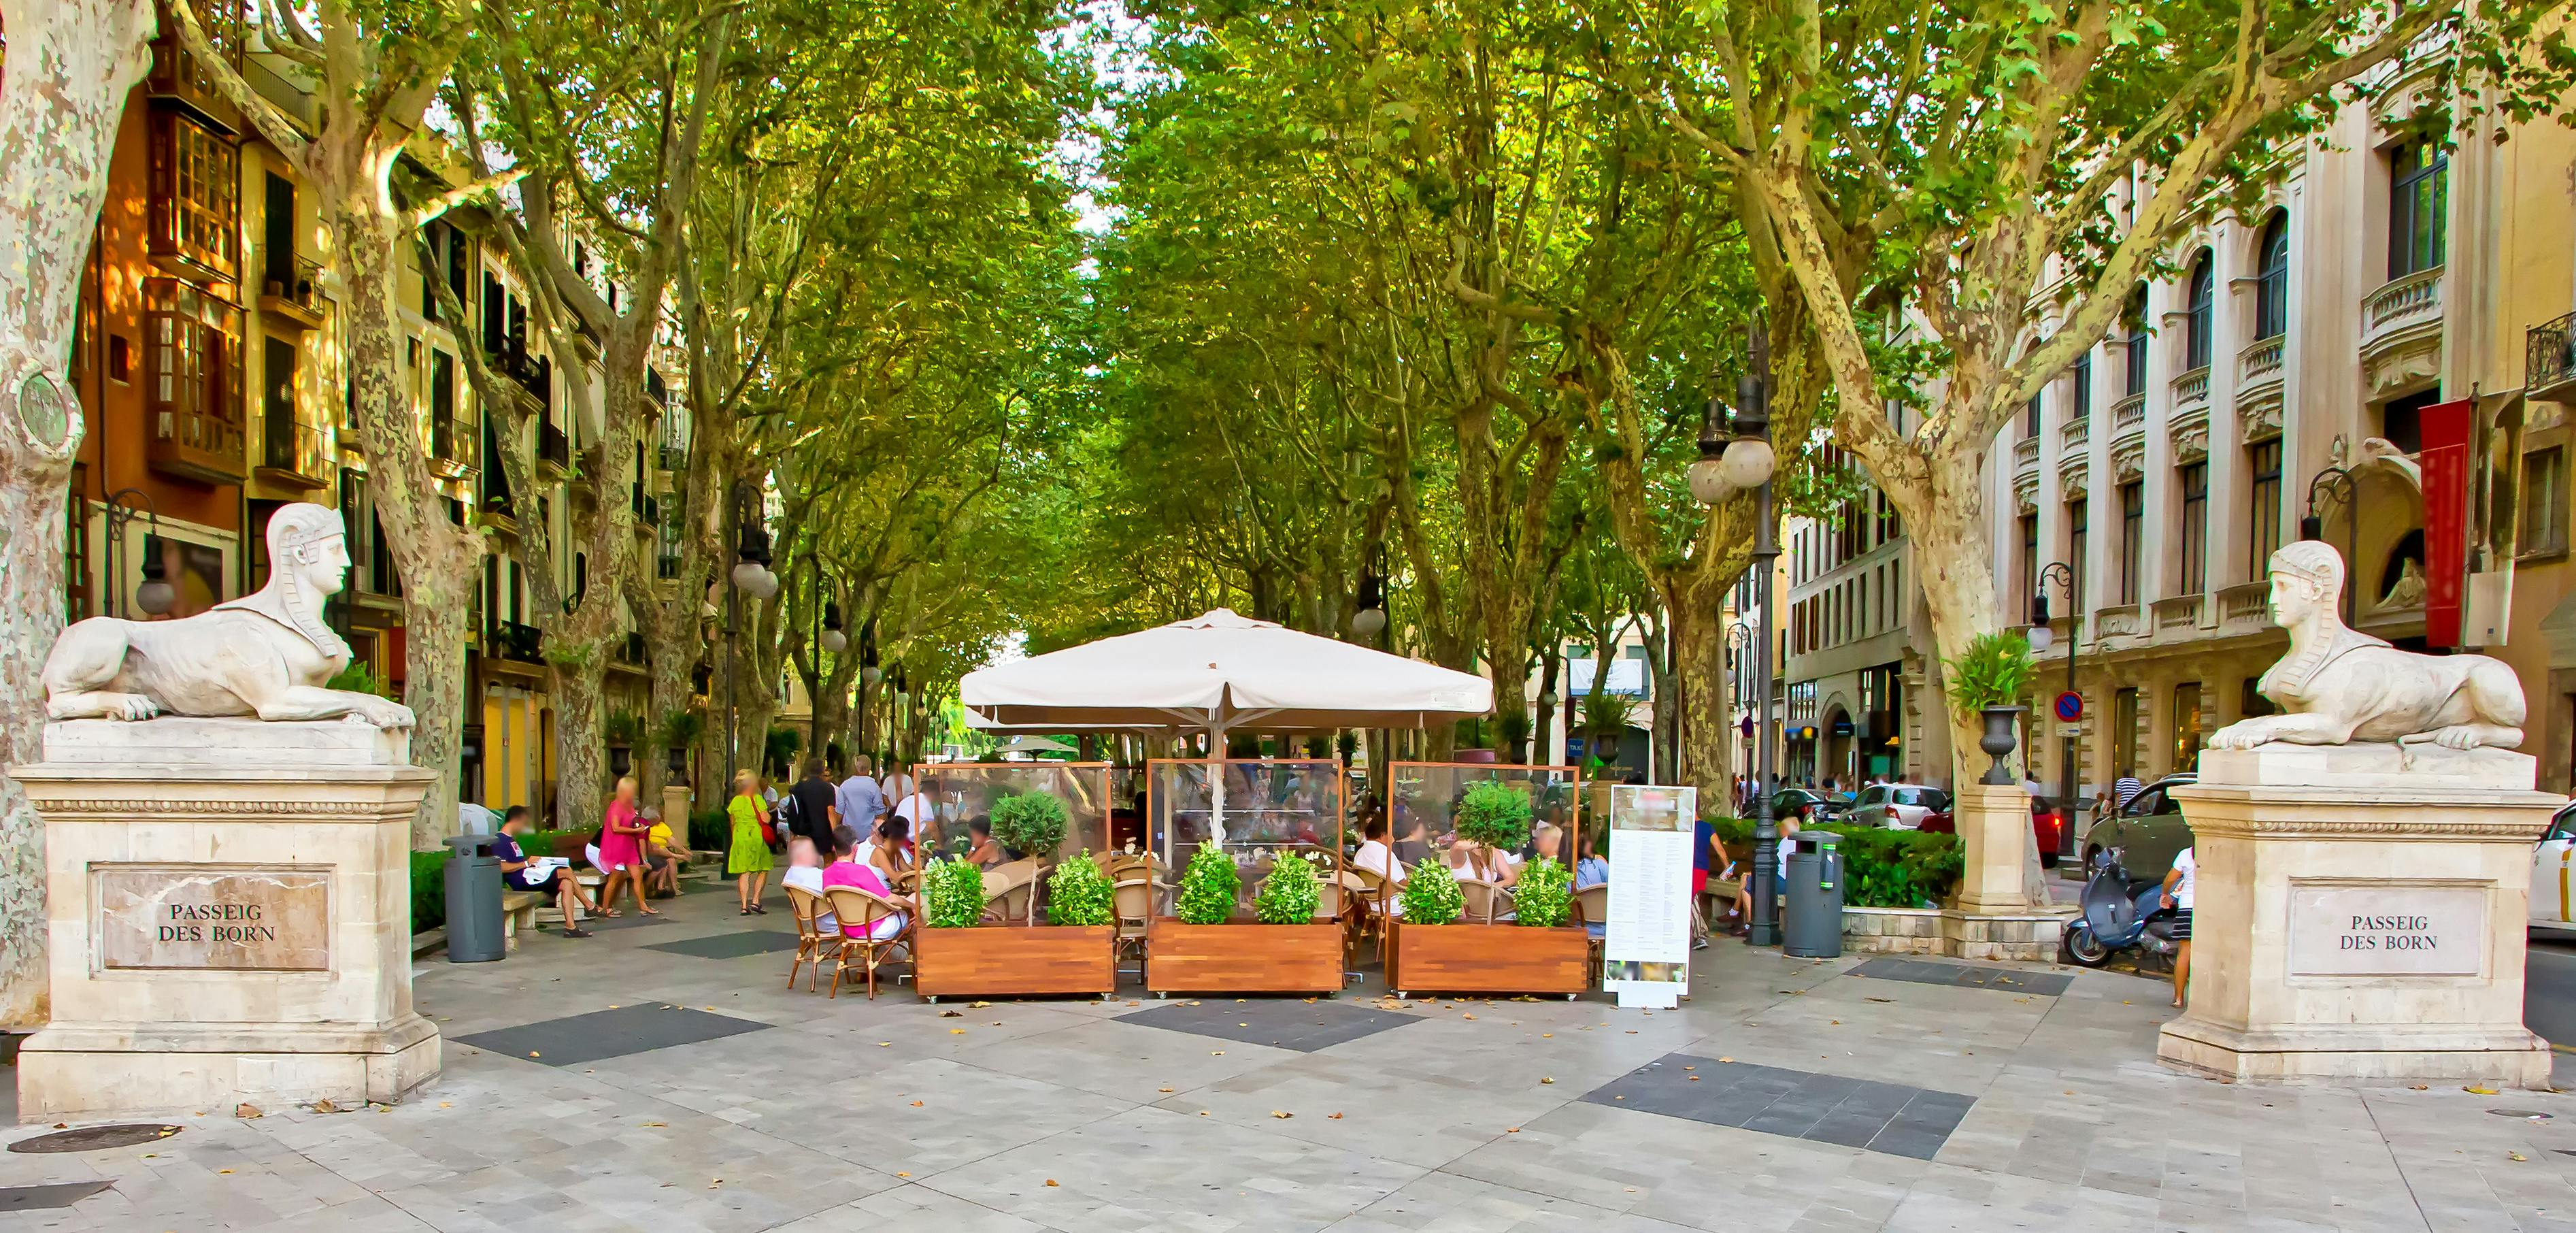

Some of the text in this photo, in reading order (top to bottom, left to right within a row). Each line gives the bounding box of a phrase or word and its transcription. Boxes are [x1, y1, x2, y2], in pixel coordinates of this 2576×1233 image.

[170, 904, 261, 920] PASSEIG
[2351, 916, 2428, 930] PASSEIG
[158, 926, 275, 942] DES BORN
[2340, 936, 2437, 950] DES BORN
